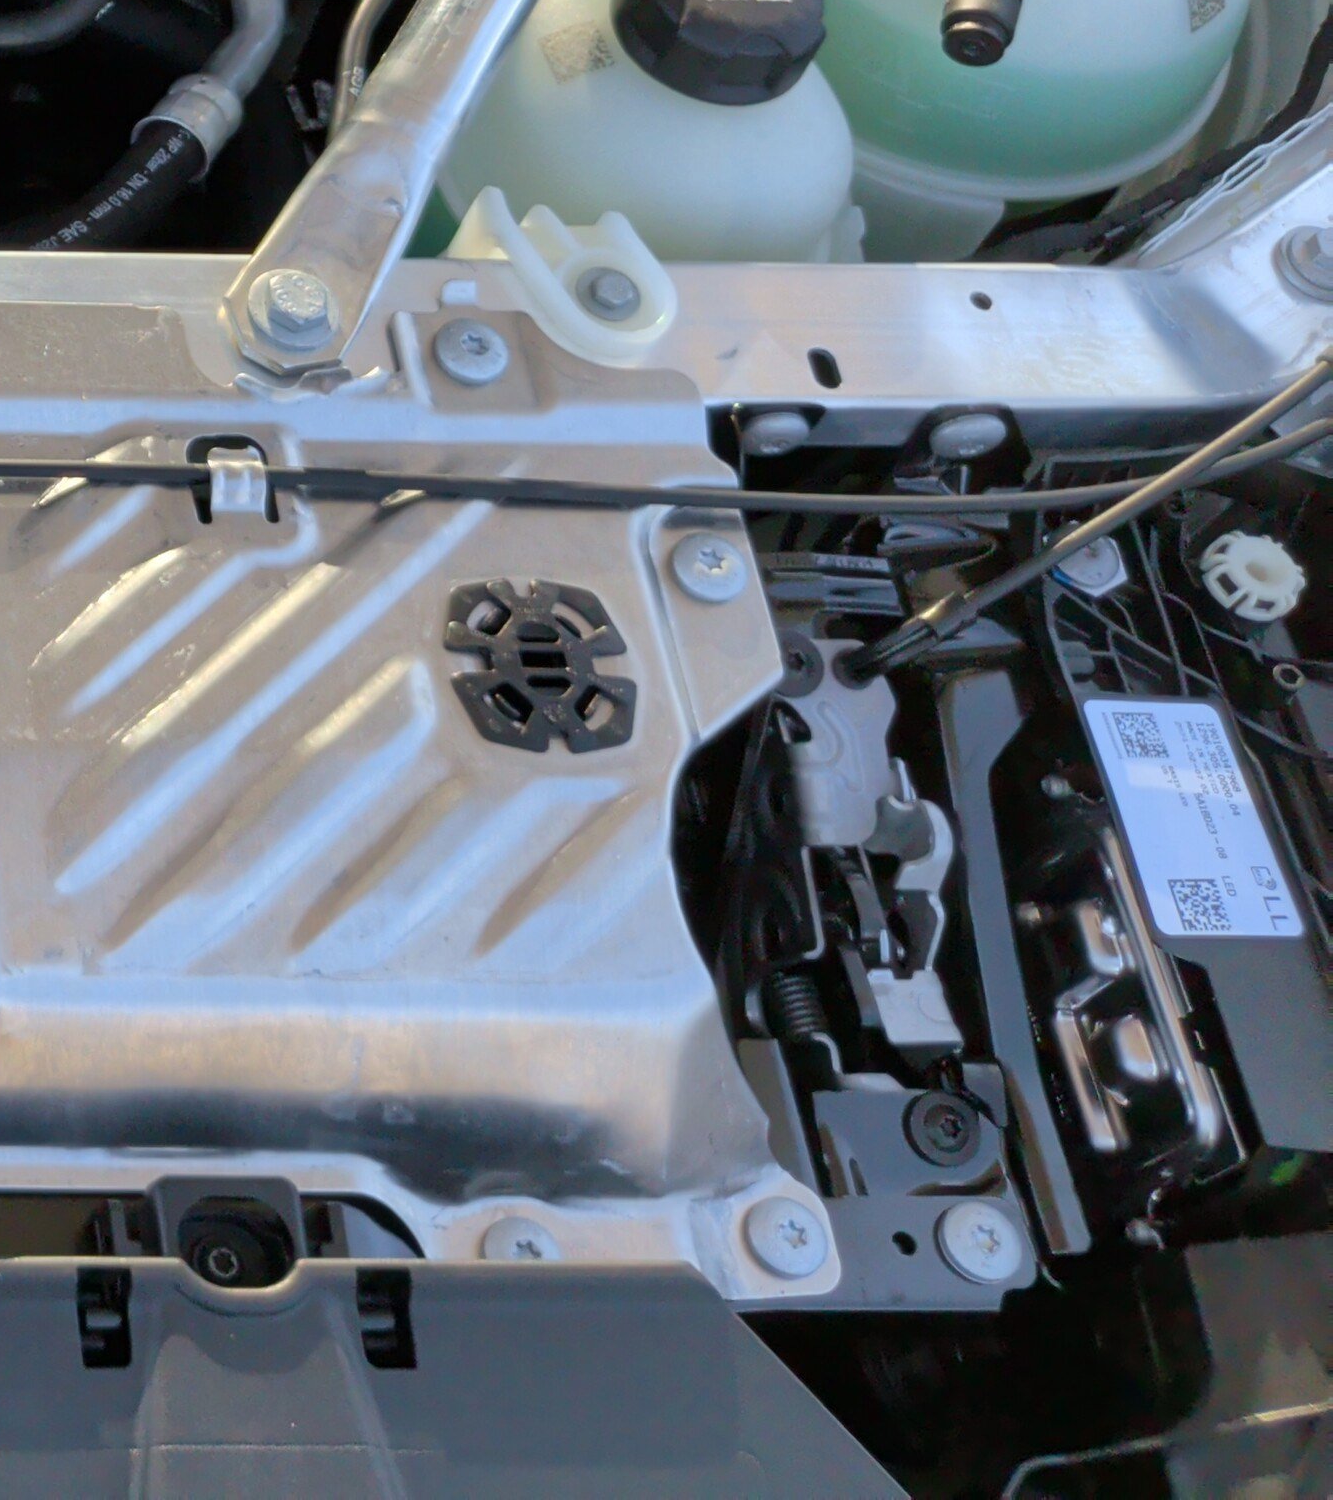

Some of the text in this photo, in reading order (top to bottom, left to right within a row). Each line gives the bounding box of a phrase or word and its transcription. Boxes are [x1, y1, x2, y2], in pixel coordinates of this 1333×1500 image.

[57, 220, 88, 243] SAE
[1215, 846, 1228, 859] 08
[1221, 875, 1237, 897] LED
